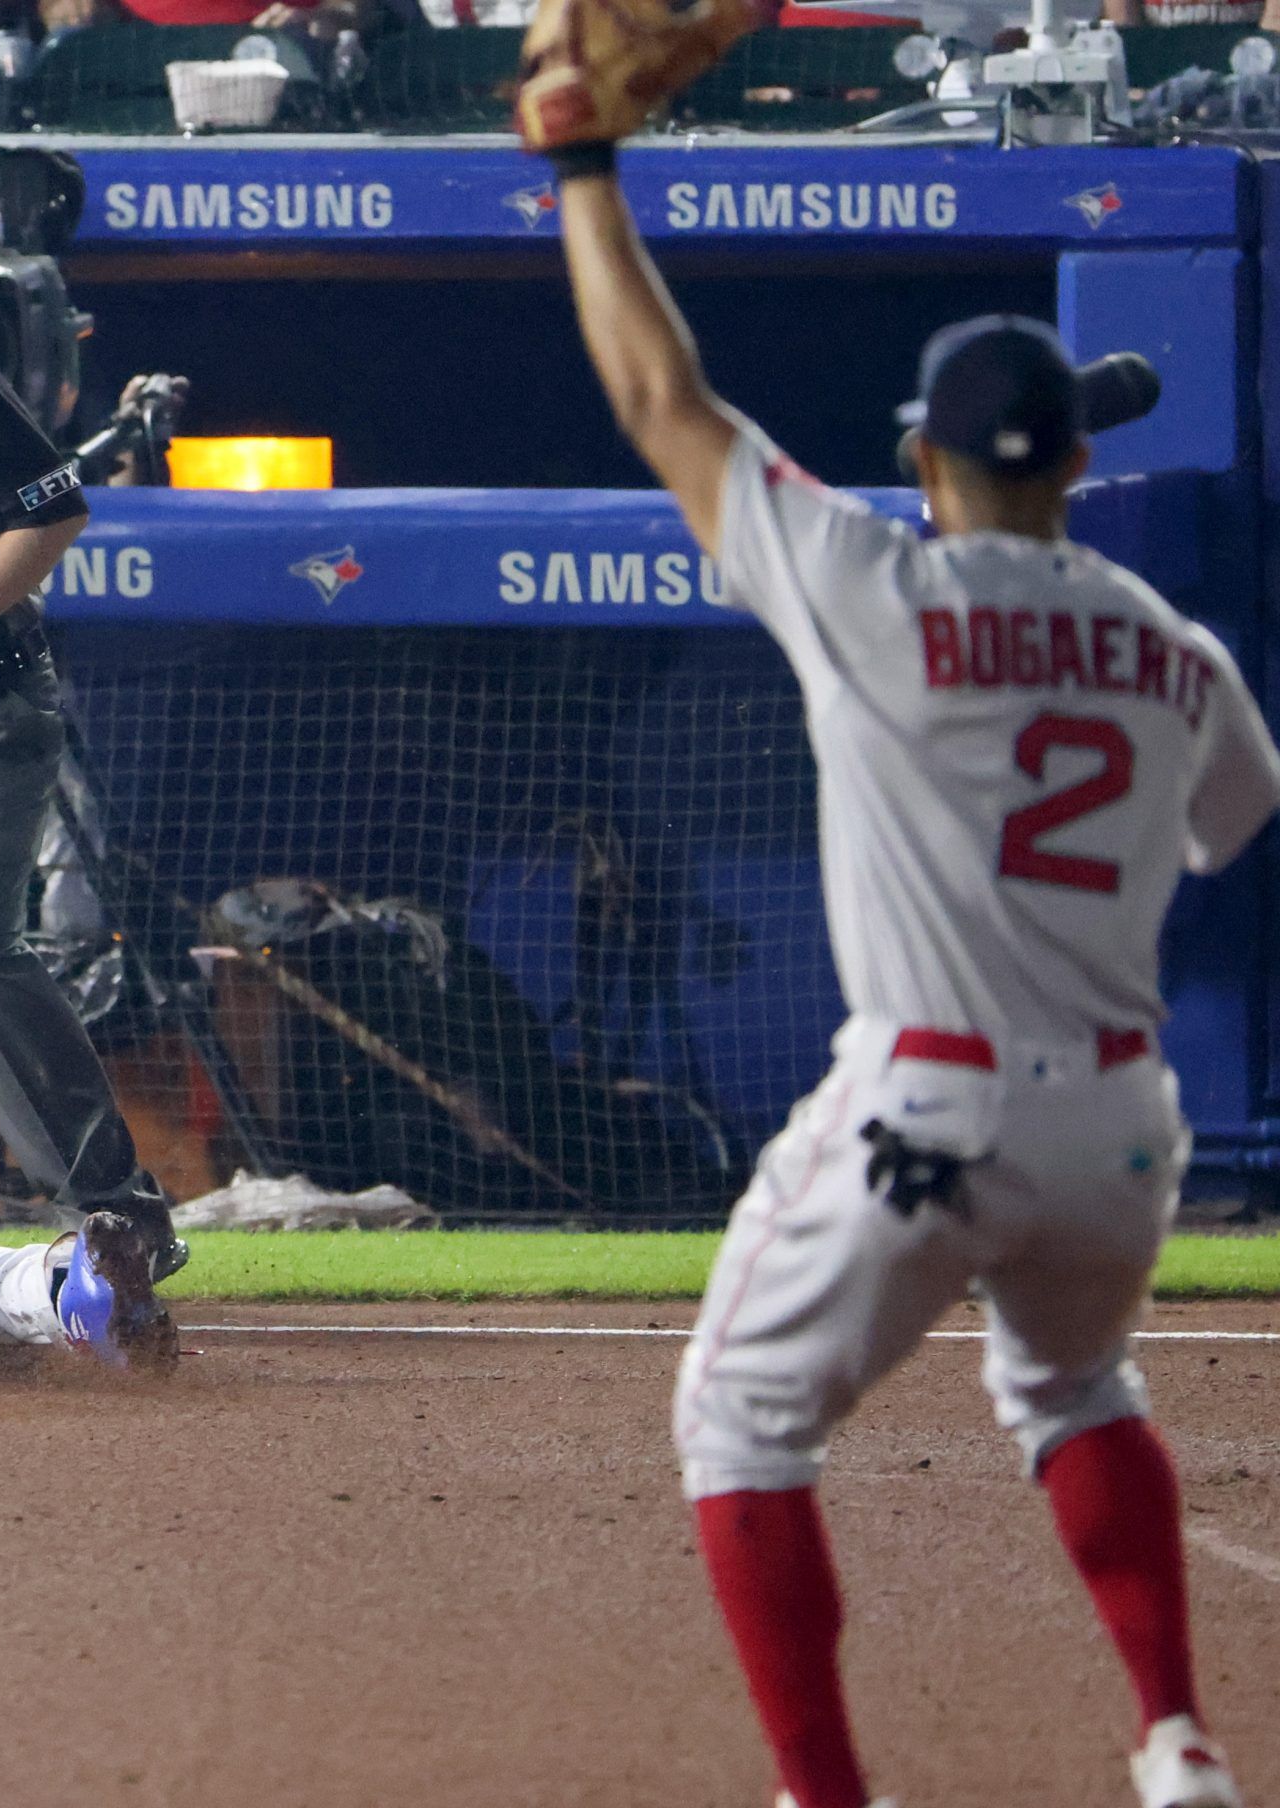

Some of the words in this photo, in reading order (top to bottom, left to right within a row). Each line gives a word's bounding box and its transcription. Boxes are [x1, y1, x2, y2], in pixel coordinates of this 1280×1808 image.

[104, 182, 394, 230] SAMSUNG
[666, 182, 958, 229] SAMSUNG
[39, 466, 81, 497] FTX
[498, 550, 731, 606] SAMSU
[919, 604, 1218, 733] BOGAERTS
[999, 710, 1134, 895] 2
